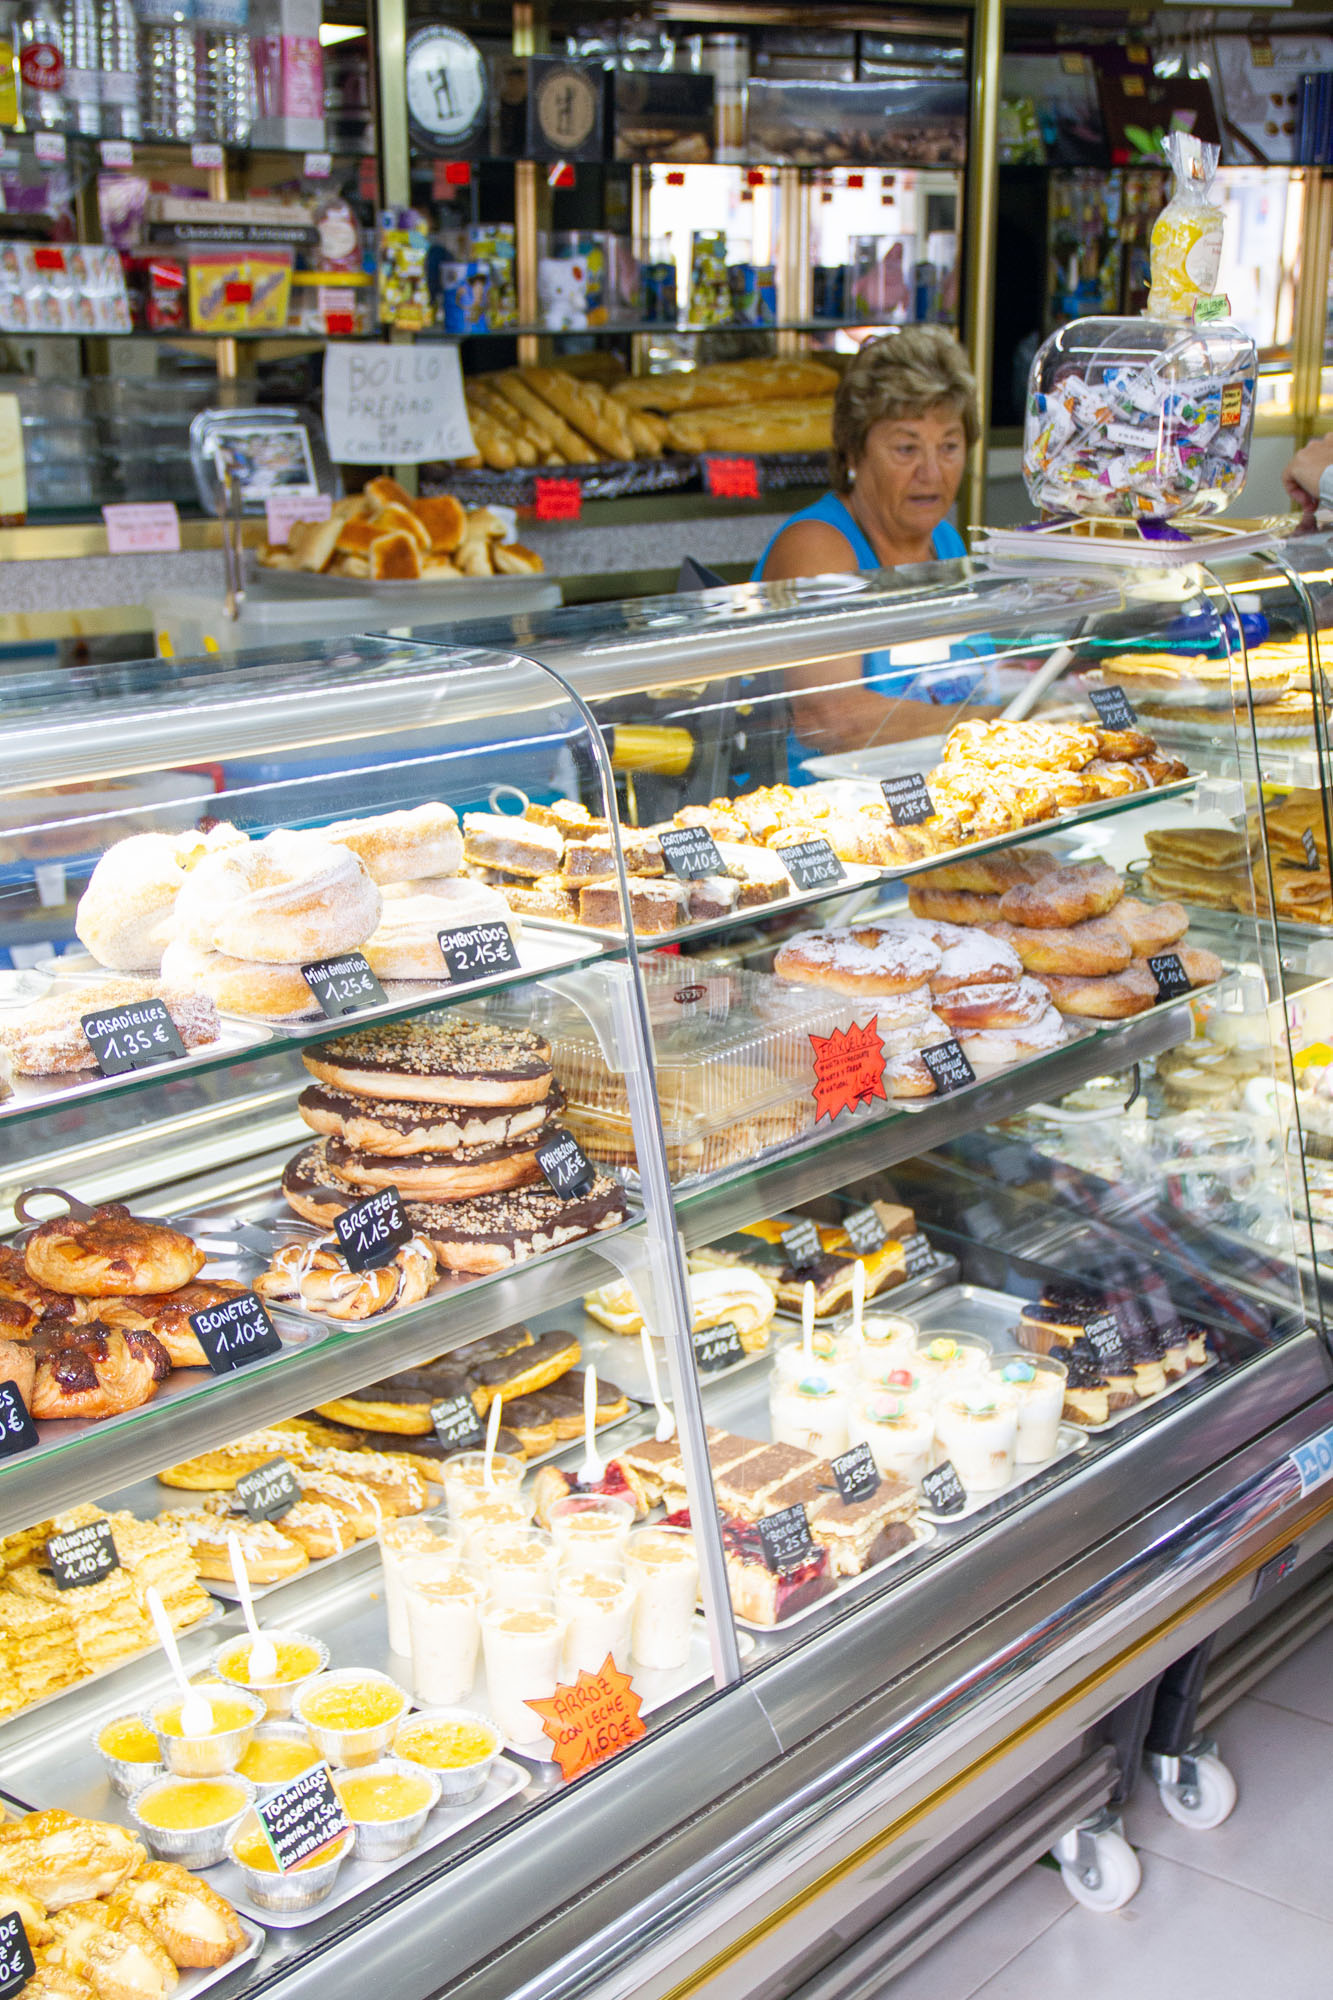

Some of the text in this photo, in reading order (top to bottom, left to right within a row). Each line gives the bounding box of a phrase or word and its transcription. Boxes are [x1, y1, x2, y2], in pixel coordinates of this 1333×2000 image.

[348, 353, 441, 393] BOLLO
[693, 828, 706, 838] DE
[802, 839, 829, 855] LUNA
[682, 851, 721, 872] 1.10€
[802, 861, 840, 883] 1.10€
[440, 925, 508, 952] EMBUTIDOS
[455, 941, 512, 969] 2.15€
[1151, 956, 1178, 972] OCHOS
[304, 957, 369, 985] MINI EMBUTIDO
[1159, 968, 1187, 984] 1.10€
[325, 974, 374, 1002] 1.25€
[85, 1007, 167, 1039] CASADIELLES
[103, 1023, 170, 1059] 1.35€
[947, 1043, 960, 1055] DE
[943, 1064, 971, 1086] 1.10€
[557, 1152, 586, 1186] 1.15€
[339, 1191, 398, 1240] BRETZEL
[356, 1209, 403, 1252] 1.15€
[196, 1297, 259, 1334] BONETES
[216, 1313, 269, 1354] 1.10€
[702, 1335, 740, 1361] 1.10€
[448, 1415, 480, 1440] 1.10€
[843, 1460, 876, 1493] 2.55€
[253, 1475, 294, 1509] 1.10€
[48, 1523, 111, 1558] MILHOJAS DE
[773, 1528, 810, 1557] 2.25€
[64, 1548, 112, 1579] 1.10€
[553, 1678, 614, 1724] ARROZ
[559, 1721, 584, 1745] CON
[580, 1714, 634, 1760] 1.60€
[281, 1850, 298, 1868] CON
[296, 1836, 318, 1858] NATA
